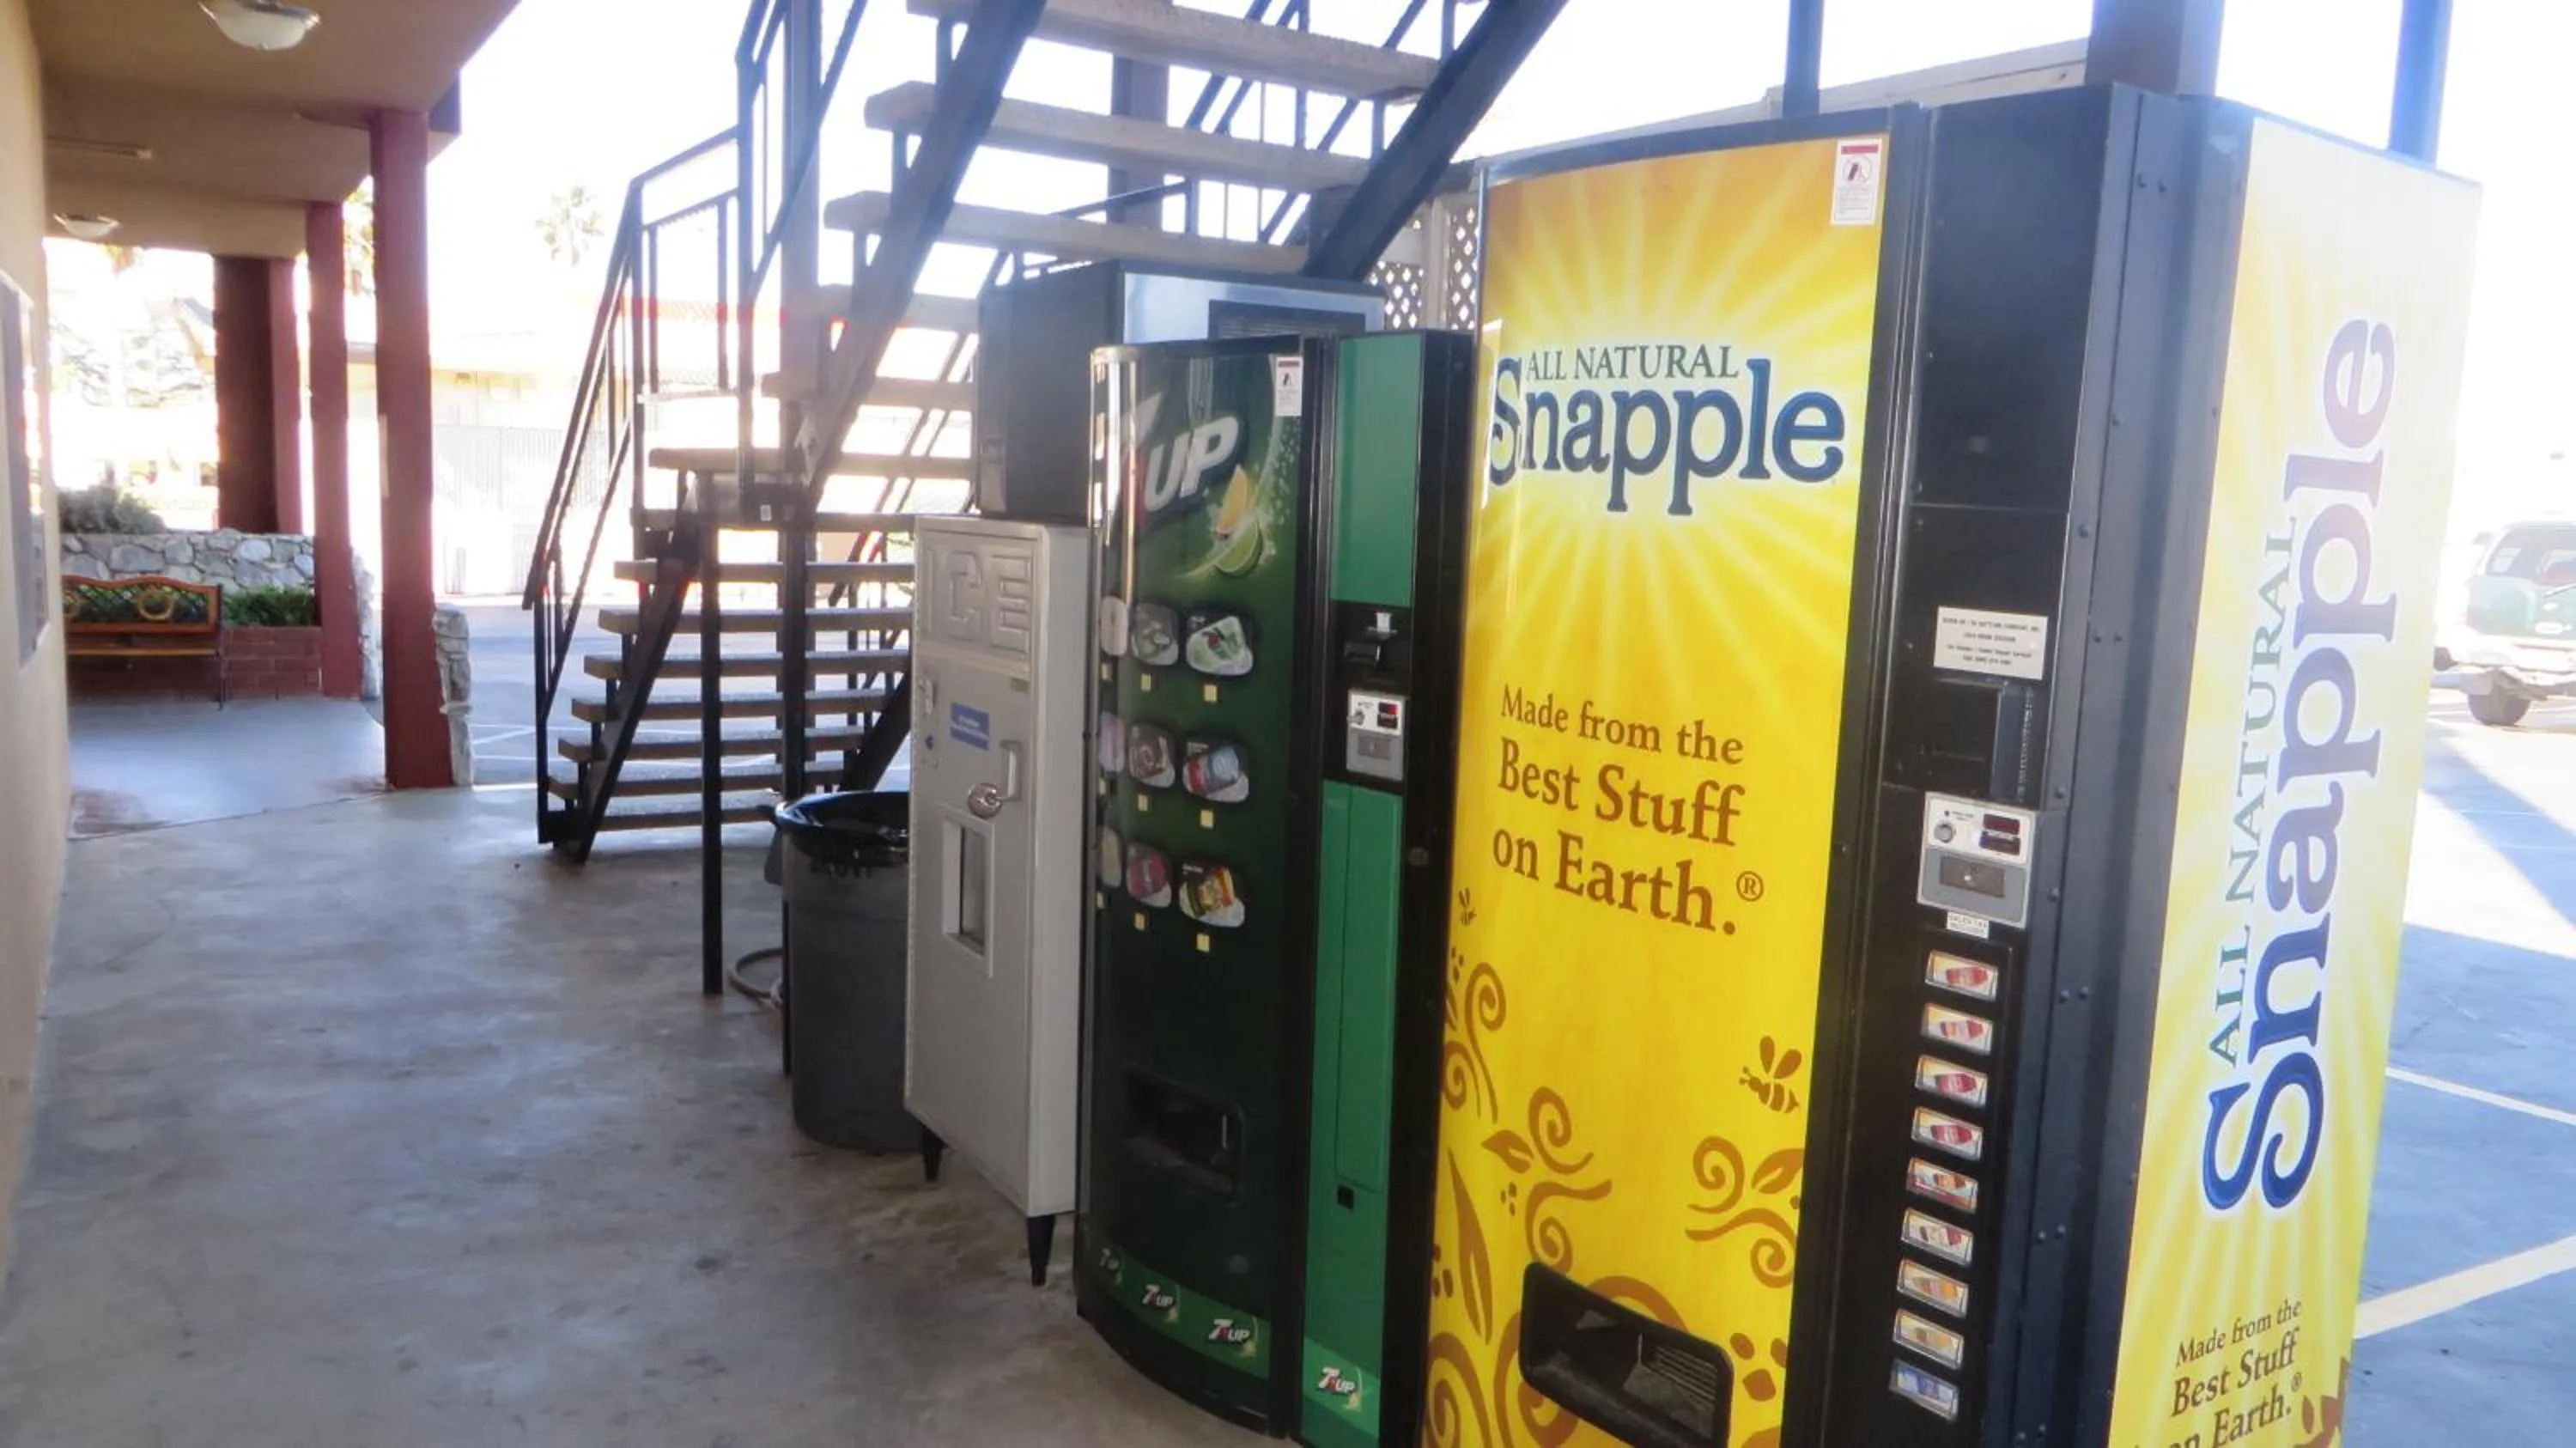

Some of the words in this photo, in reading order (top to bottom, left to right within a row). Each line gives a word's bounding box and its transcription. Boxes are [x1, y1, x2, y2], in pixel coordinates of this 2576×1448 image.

[1526, 350, 1568, 381] ALL
[1574, 344, 1741, 380] NATURAL
[1487, 356, 1846, 515] Snapple
[921, 547, 1032, 655] ICE
[1501, 684, 1570, 733] Made
[1578, 700, 1662, 754] from
[1676, 720, 1744, 765] the
[2224, 516, 2297, 904] NATURAL
[1498, 736, 1581, 812] Best
[1595, 764, 1746, 848] Stuff
[2202, 318, 2397, 1210] Snapple
[1492, 829, 1540, 882] on
[2208, 924, 2251, 1069] ALL
[1208, 1318, 1251, 1342] 7UP
[2170, 1366, 2231, 1417] Best
[2237, 1326, 2300, 1389] Stuff
[2175, 1327, 2227, 1369] Made
[2232, 1314, 2272, 1345] from
[2277, 1299, 2302, 1324] the
[1318, 1366, 1356, 1393] 7UP
